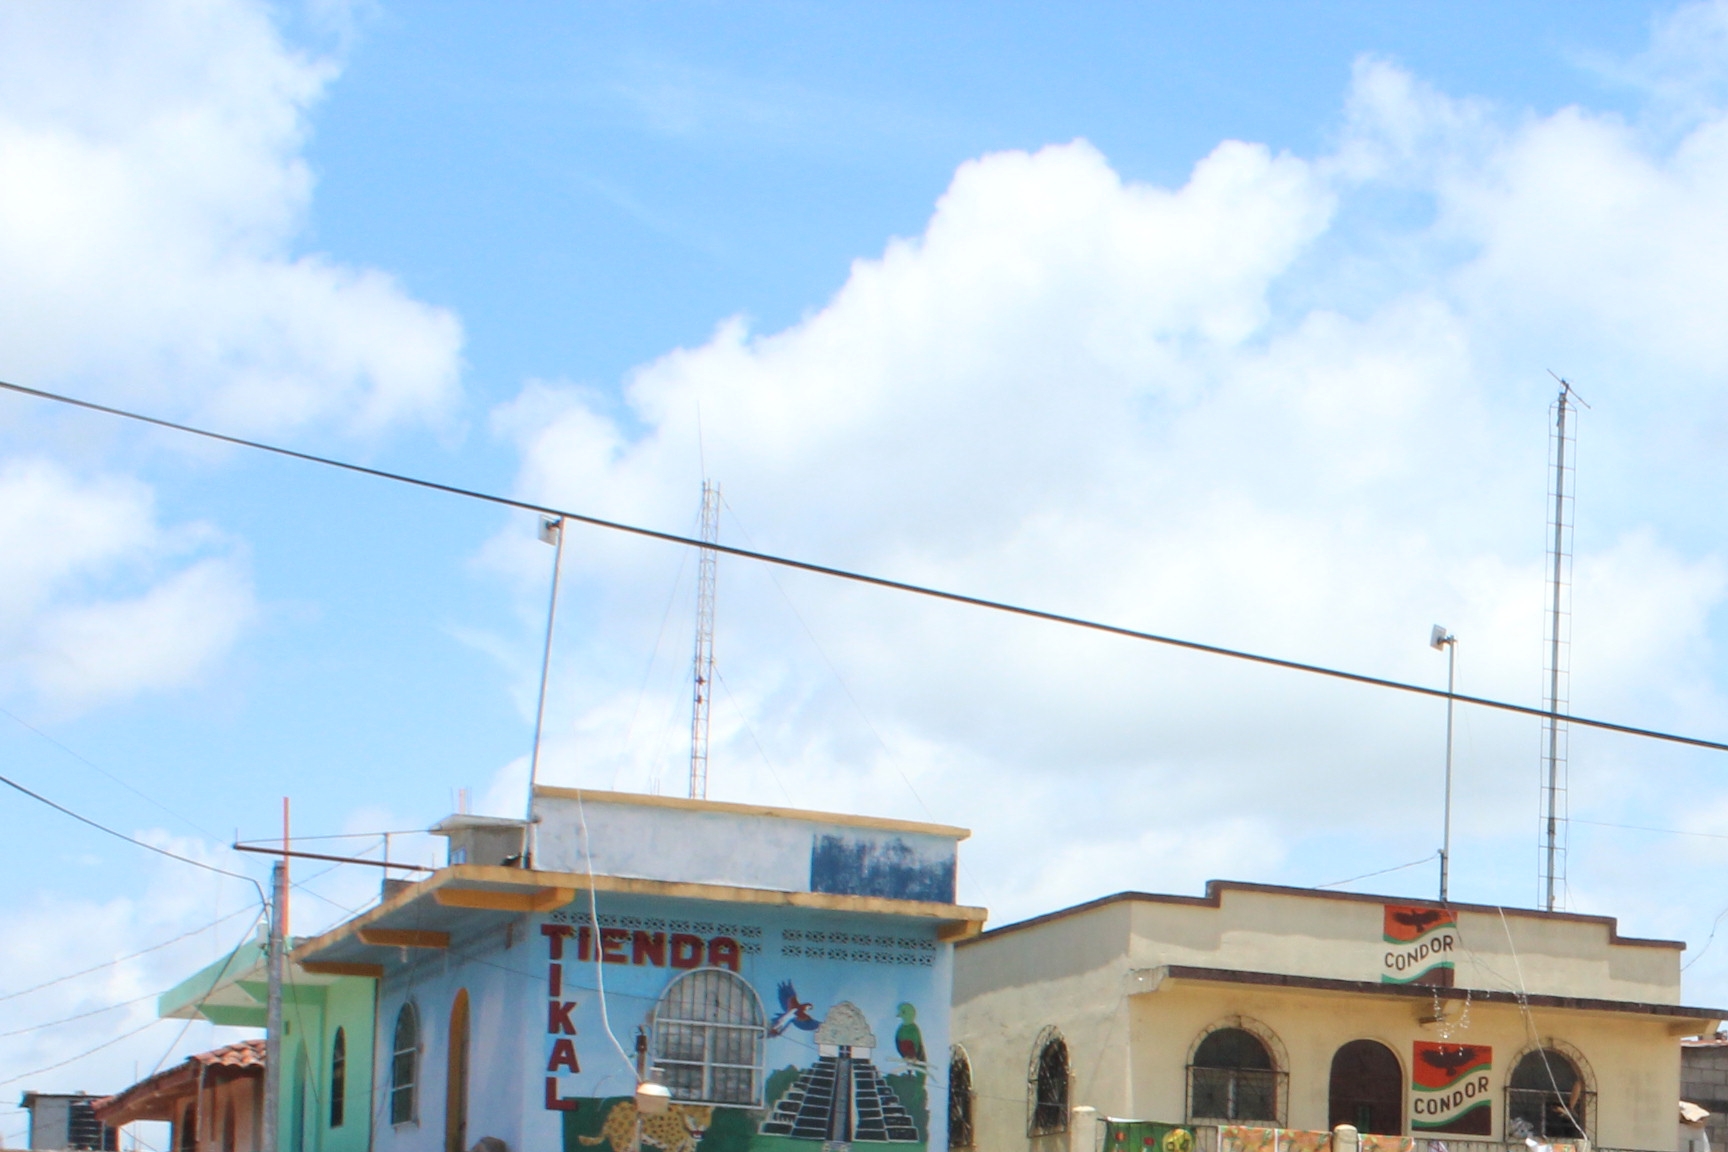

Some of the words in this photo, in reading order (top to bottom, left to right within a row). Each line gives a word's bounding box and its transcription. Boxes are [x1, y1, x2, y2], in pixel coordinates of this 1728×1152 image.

[541, 923, 741, 972] TIENDA
[1384, 934, 1454, 971] CONDOR
[1414, 1076, 1490, 1115] CONDOR
